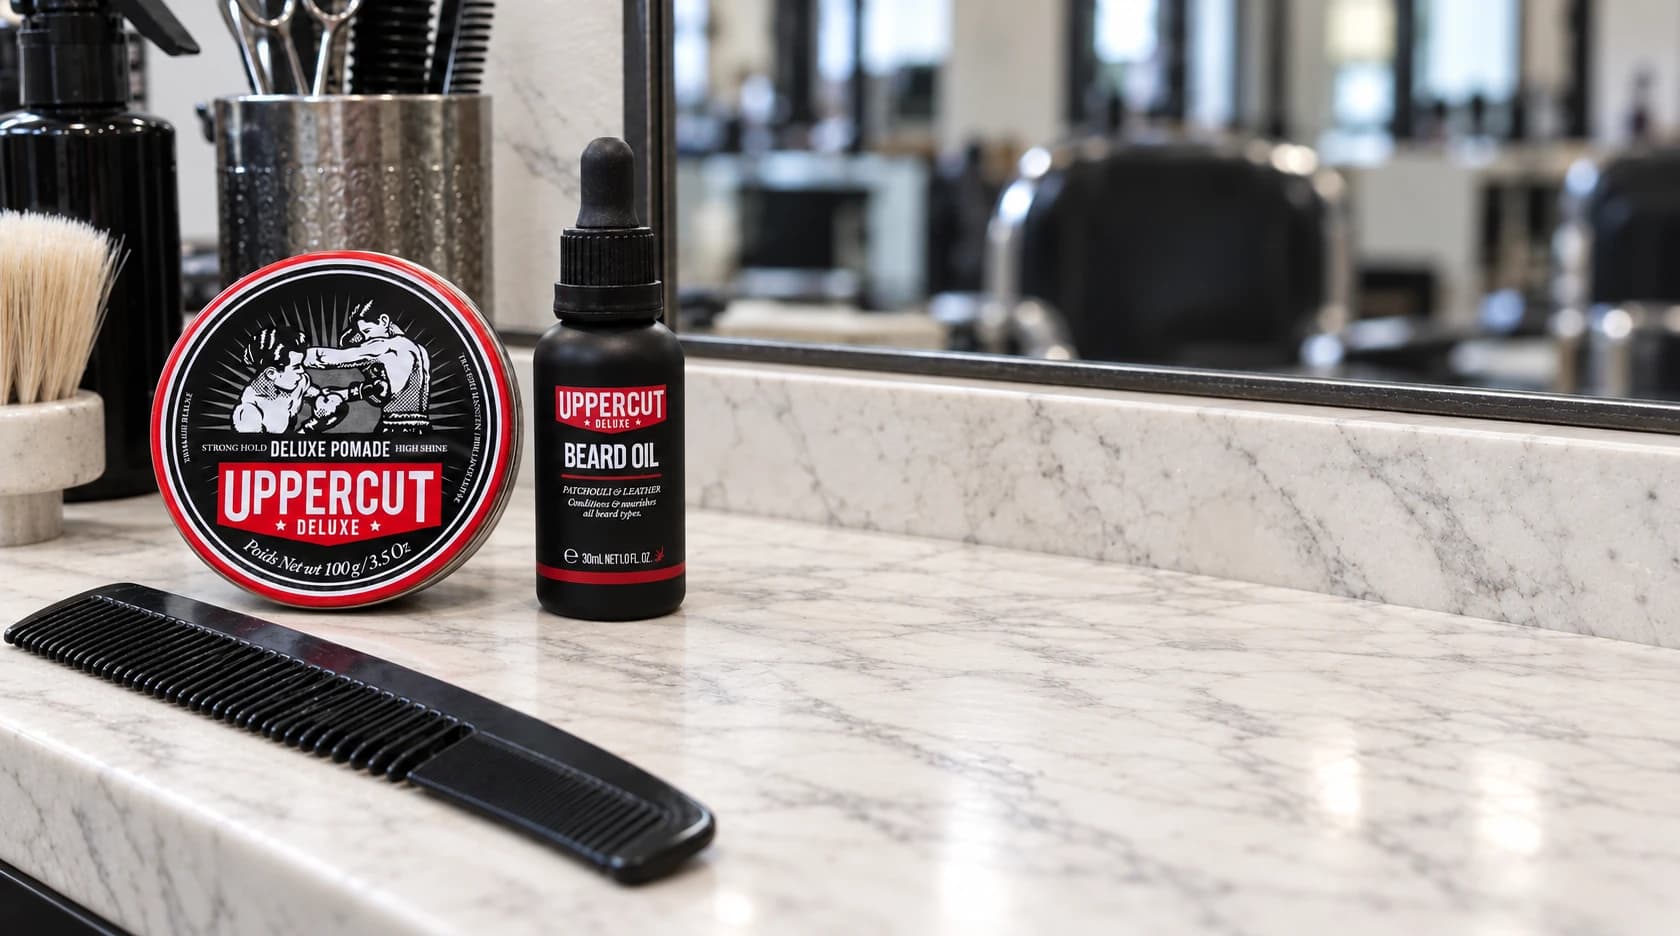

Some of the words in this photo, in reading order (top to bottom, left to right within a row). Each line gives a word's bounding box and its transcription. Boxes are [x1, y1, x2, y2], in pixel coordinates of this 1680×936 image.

[559, 389, 665, 420] UPPERCUT
[595, 418, 630, 429] DELUXE
[201, 443, 239, 453] STRONG
[240, 443, 268, 452] HOLD
[270, 440, 327, 458] DELUXE
[330, 440, 391, 458] POMADE
[395, 444, 418, 453] HIGH
[419, 444, 448, 453] SHINE
[564, 442, 627, 470] BEARD
[631, 442, 660, 469] OIL
[224, 469, 434, 523] UPPERCUT
[562, 485, 612, 497] PATCHOULI
[622, 485, 662, 496] LEATHER
[611, 500, 621, 508] &
[582, 509, 594, 518] all
[595, 509, 619, 518] beard
[296, 518, 360, 536] DELUXE
[243, 538, 279, 566] Poids
[277, 555, 302, 574] Net
[303, 564, 322, 576] wt
